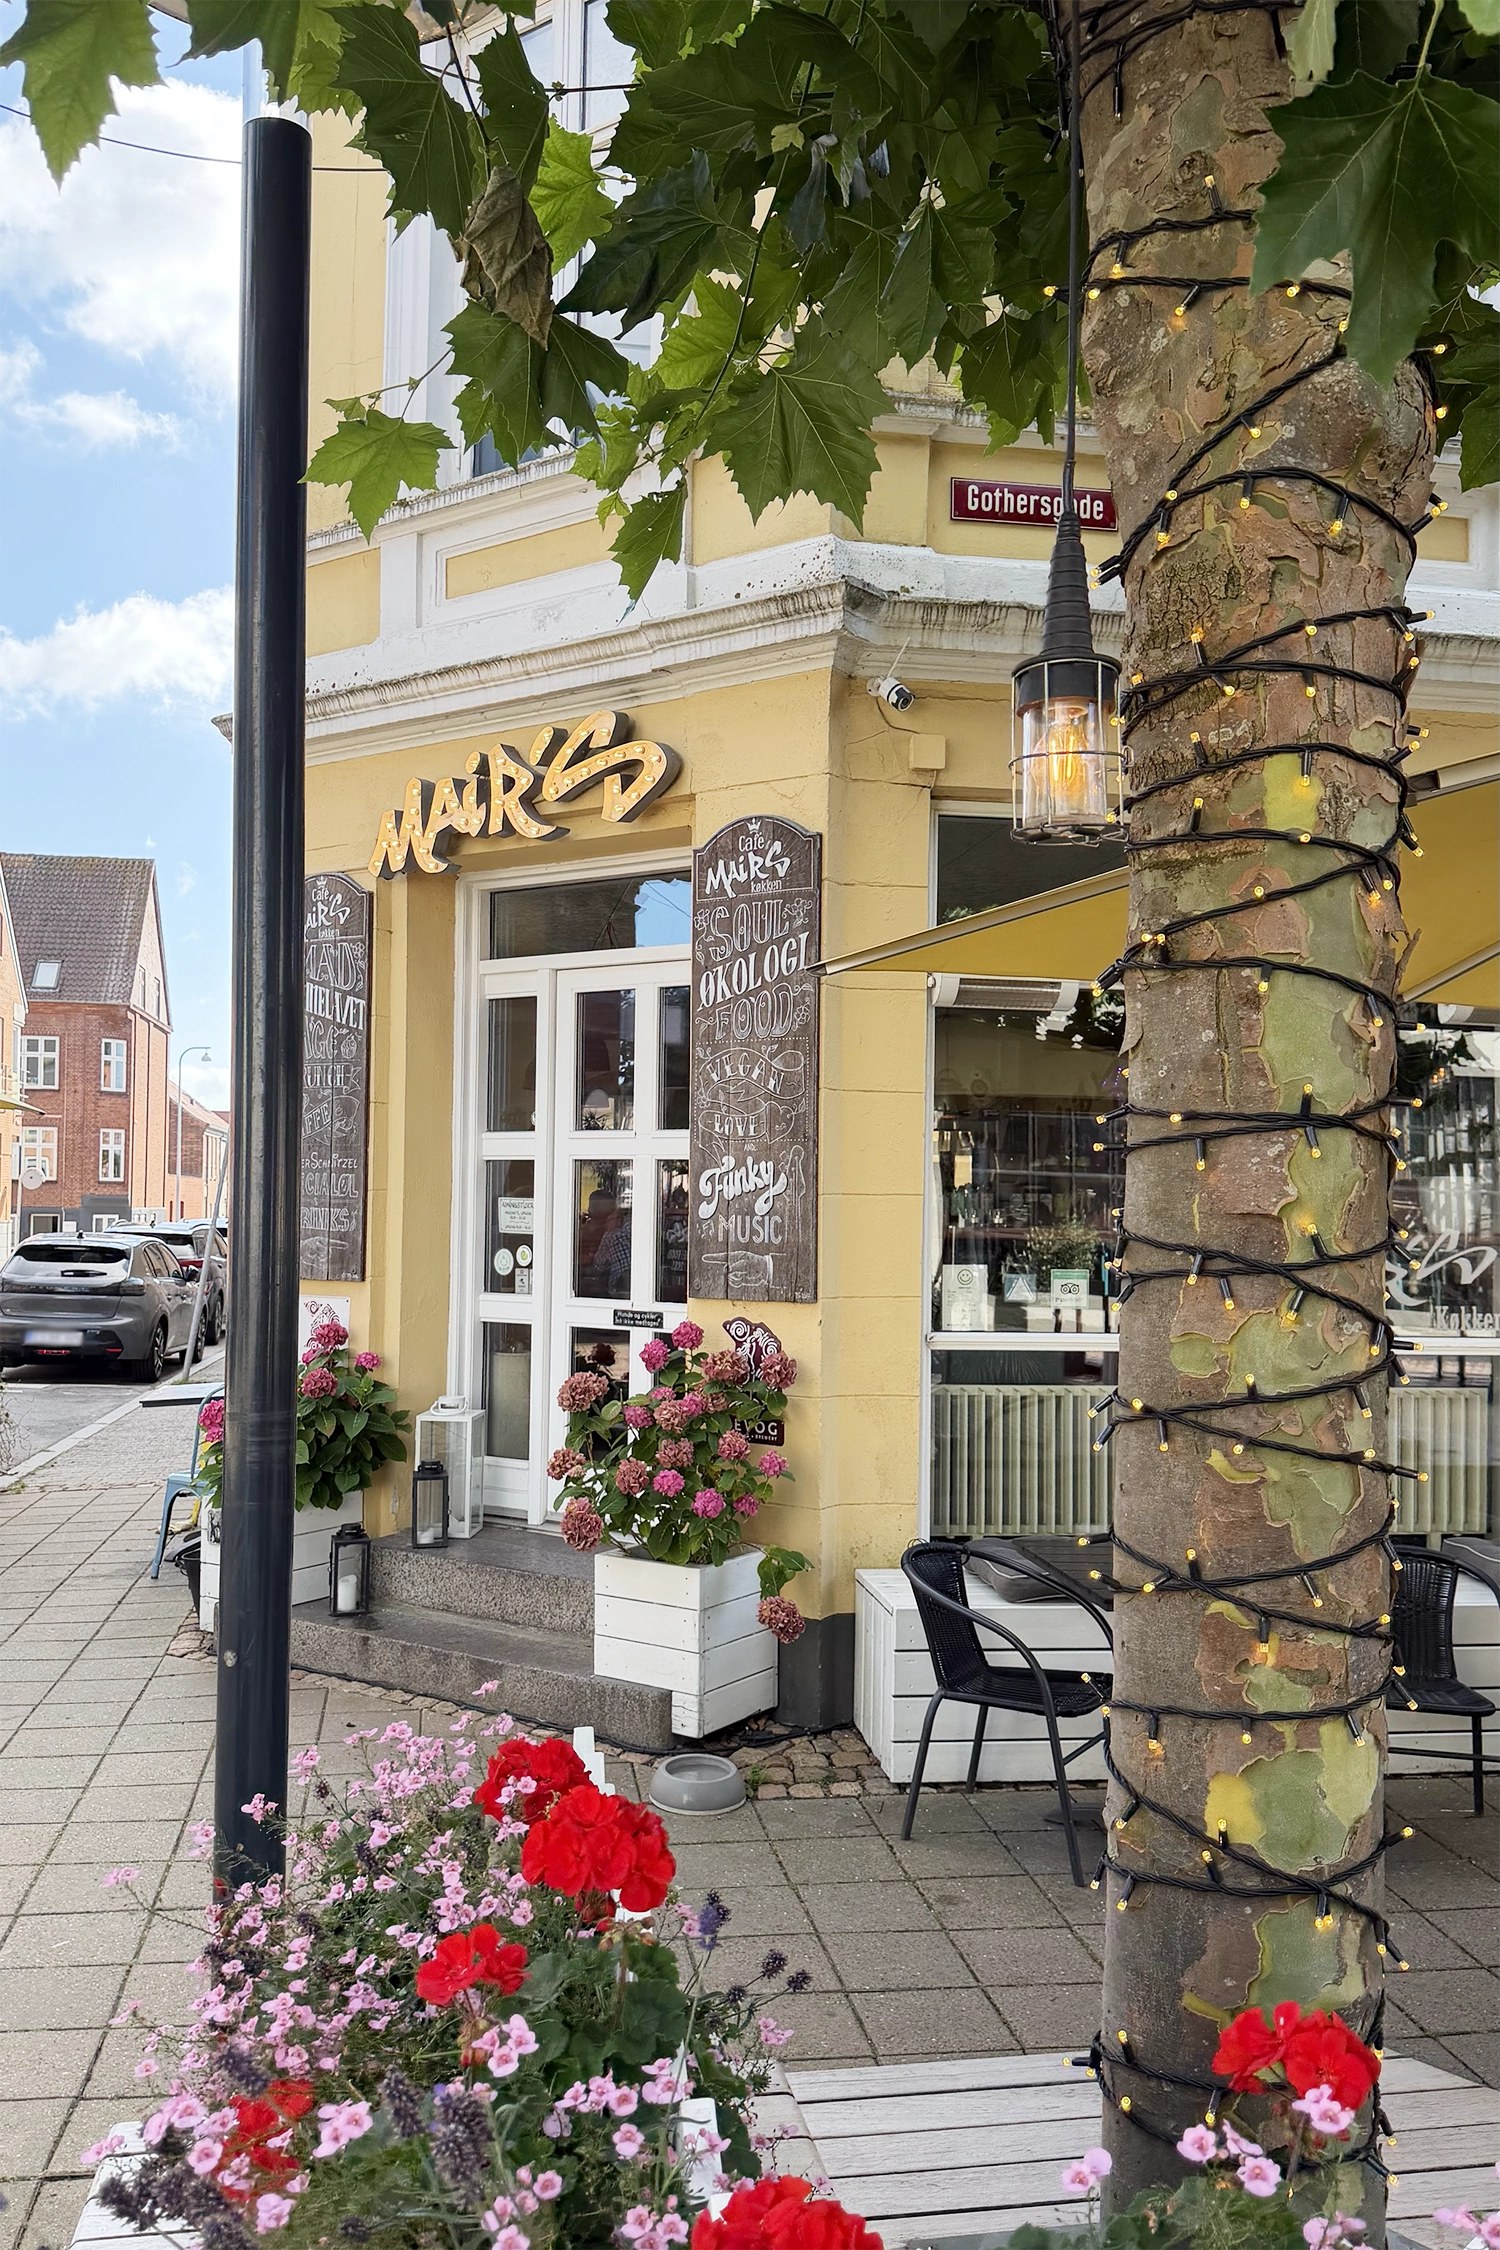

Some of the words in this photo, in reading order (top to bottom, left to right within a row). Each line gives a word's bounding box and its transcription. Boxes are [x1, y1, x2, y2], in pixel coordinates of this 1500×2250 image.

[967, 484, 1104, 522] Gothersgde
[738, 831, 766, 853] Café
[312, 888, 330, 901] Café
[751, 879, 783, 893] køkken
[709, 899, 789, 962] SOUL
[697, 931, 810, 1012] ØKOLOGI
[714, 982, 794, 1041] FOOD
[303, 1065, 344, 1088] UNCH
[706, 1052, 785, 1095] VEGAN
[302, 1103, 331, 1134] FFE
[714, 1114, 758, 1137] LOVE
[301, 1152, 358, 1169] ERSCHNITZEL
[301, 1172, 358, 1198] CIALØL
[699, 1155, 788, 1219] Funky
[301, 1206, 350, 1232] RINKS
[718, 1214, 783, 1244] MUSIC
